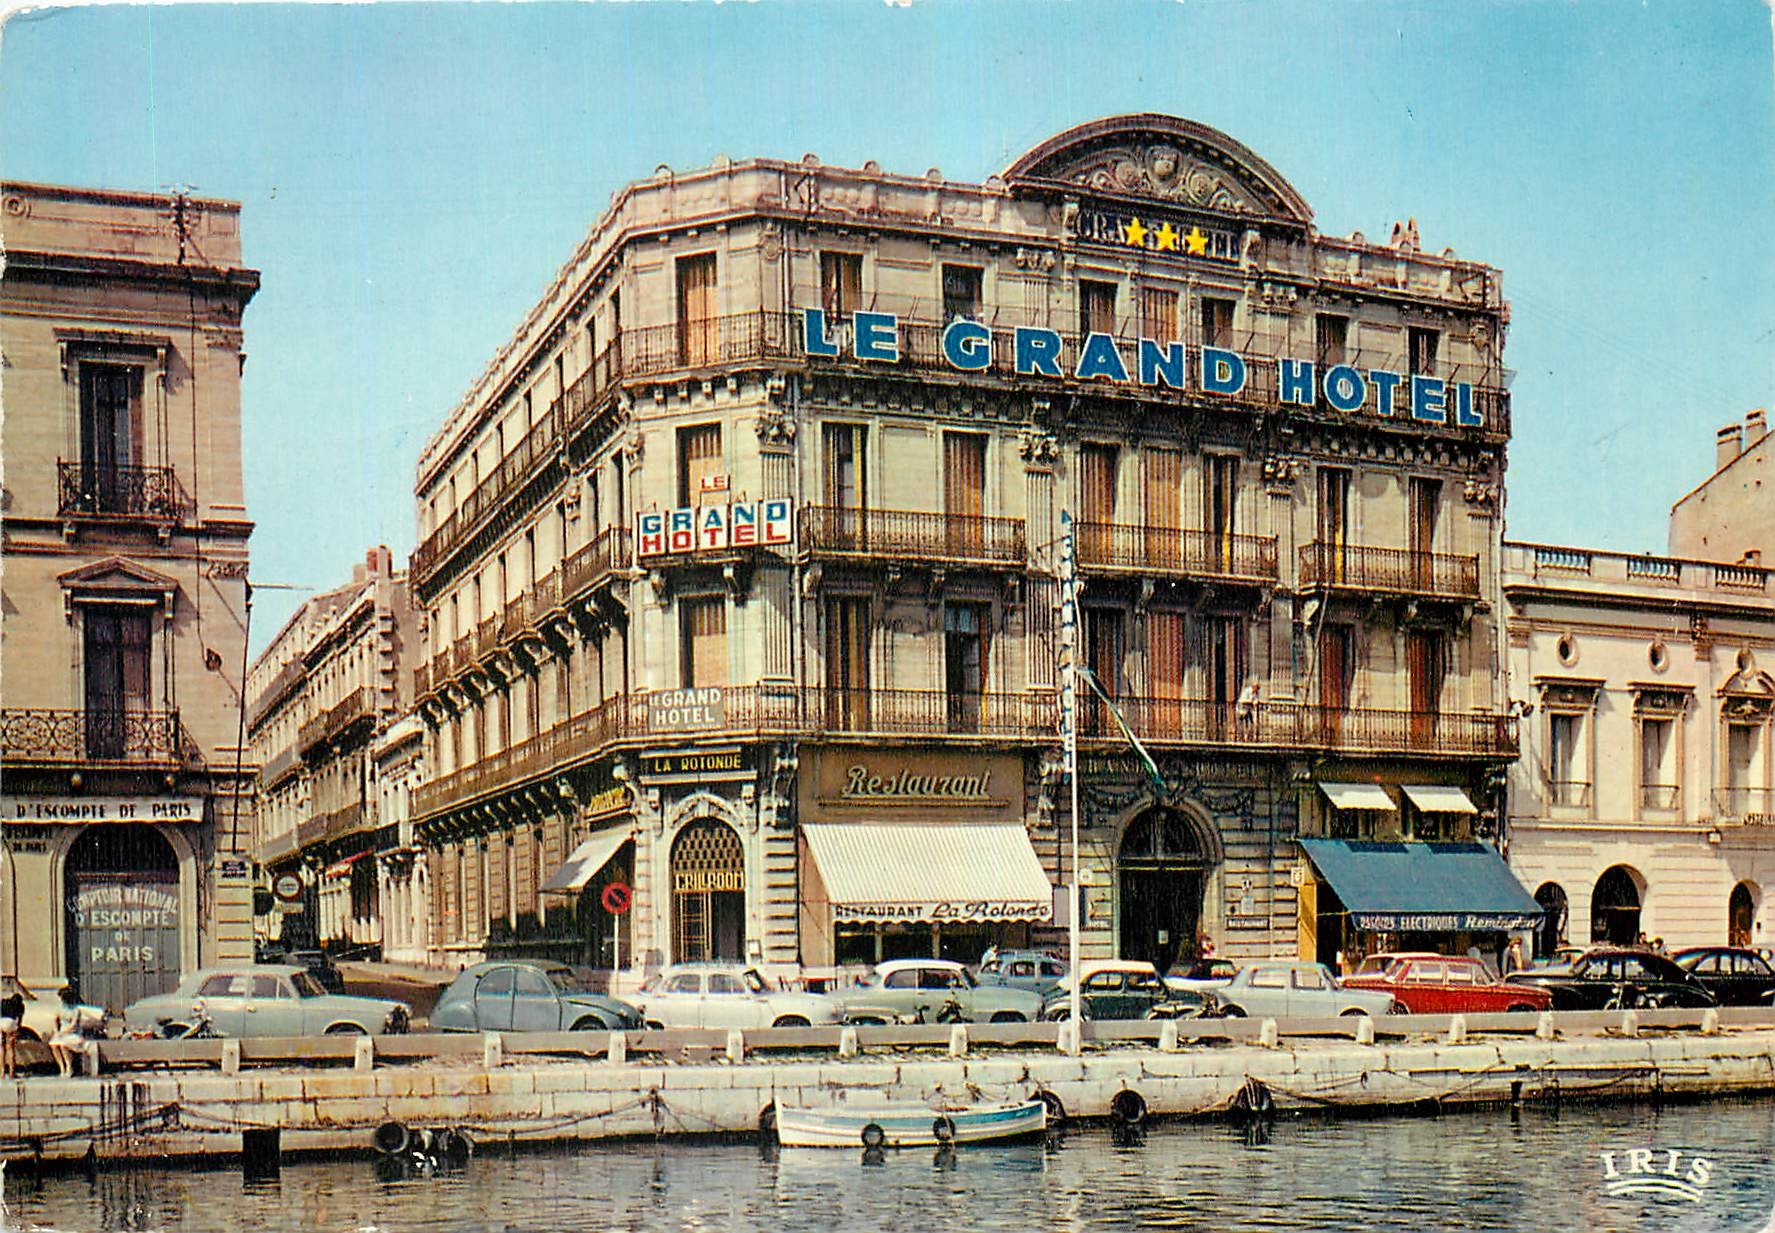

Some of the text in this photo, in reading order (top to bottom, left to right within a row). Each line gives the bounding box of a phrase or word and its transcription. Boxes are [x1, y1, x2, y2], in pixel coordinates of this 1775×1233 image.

[803, 308, 1484, 428] LE GRAND HOTEL
[701, 476, 725, 489] LE
[642, 502, 786, 534] GRAND
[642, 522, 786, 553] HOTEL
[662, 688, 721, 707] GRAND
[655, 706, 715, 726] HOTEL
[655, 755, 741, 773] LA ROTONDE
[842, 764, 991, 798] Restaurant
[16, 802, 191, 818] D'ESCOMPTE DE PARIS
[834, 904, 923, 918] RESTAURANT
[931, 902, 960, 919] La
[91, 946, 153, 962] PARIS
